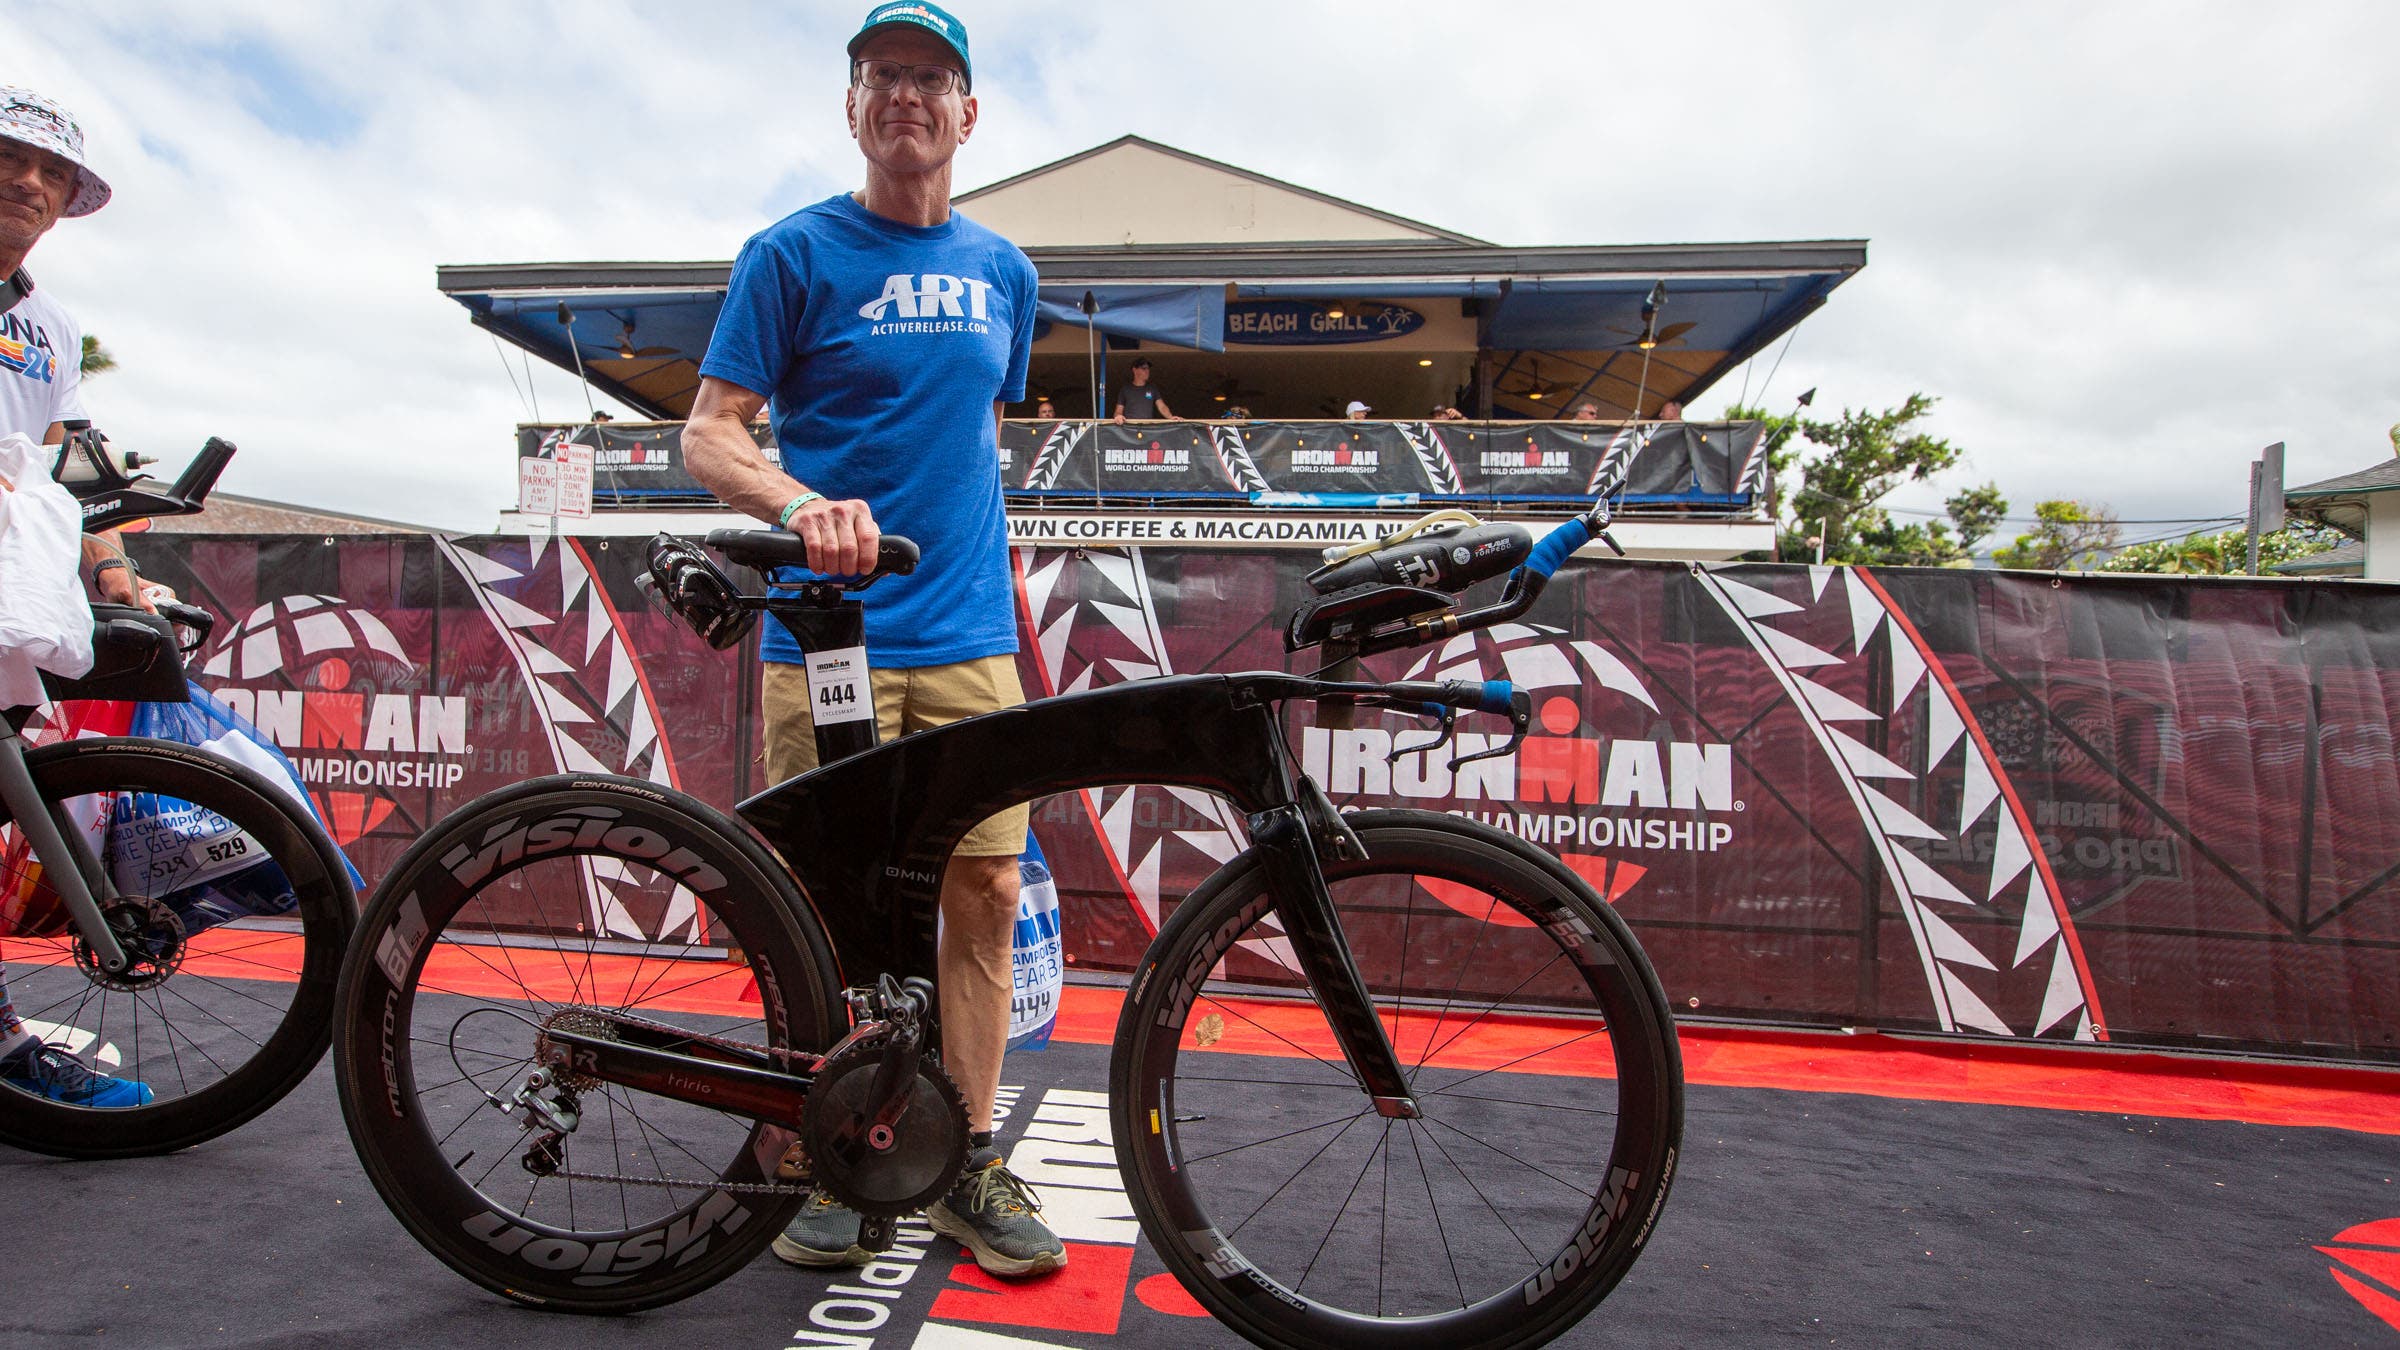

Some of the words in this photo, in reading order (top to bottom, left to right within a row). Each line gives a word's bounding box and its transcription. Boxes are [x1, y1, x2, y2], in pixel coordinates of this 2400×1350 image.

[858, 274, 993, 321] ART
[871, 321, 989, 336] ACTIVERELEASE.COM
[1229, 312, 1298, 333] BEACH
[1310, 312, 1369, 331] GRILL
[557, 447, 568, 459] NO
[569, 451, 588, 459] PARKING
[595, 449, 669, 463] IRONMAN
[1105, 449, 1190, 464] IRONMAN
[1291, 450, 1379, 465] IRONMAN
[1480, 451, 1570, 467] IRONMAN
[533, 464, 547, 475] NO
[574, 466, 586, 474] MIN
[619, 464, 669, 472] CHAMPIONSHIP
[1105, 465, 1129, 473] WORLD
[1131, 465, 1189, 473] CHAMPIONSHIP
[1480, 467, 1506, 475] WORLD
[1508, 467, 1569, 475] CHAMPIONSHIP
[522, 474, 556, 487] PARKING
[559, 473, 589, 482] LOADING
[532, 487, 546, 495] ANY
[563, 482, 581, 490] ZONE
[1064, 520, 1164, 537] COFFEE
[1170, 521, 1187, 537] &
[1196, 521, 1368, 540] MACADAMIA
[1475, 543, 1512, 557] TORPEDO
[816, 659, 850, 671] IRONMAN
[820, 683, 856, 706] 444
[106, 744, 150, 754] GRAND
[150, 746, 182, 758] PRIX
[181, 753, 215, 766] 5000
[1302, 726, 1732, 812] IRONMAN
[572, 780, 667, 802] CONTINENTAL
[145, 823, 208, 855] GEAR
[206, 836, 248, 863] 529
[885, 866, 936, 884] OMNI
[1135, 967, 1151, 1005] 5000
[382, 988, 404, 1117] metron
[1632, 1147, 1675, 1249] CONTINENTAL
